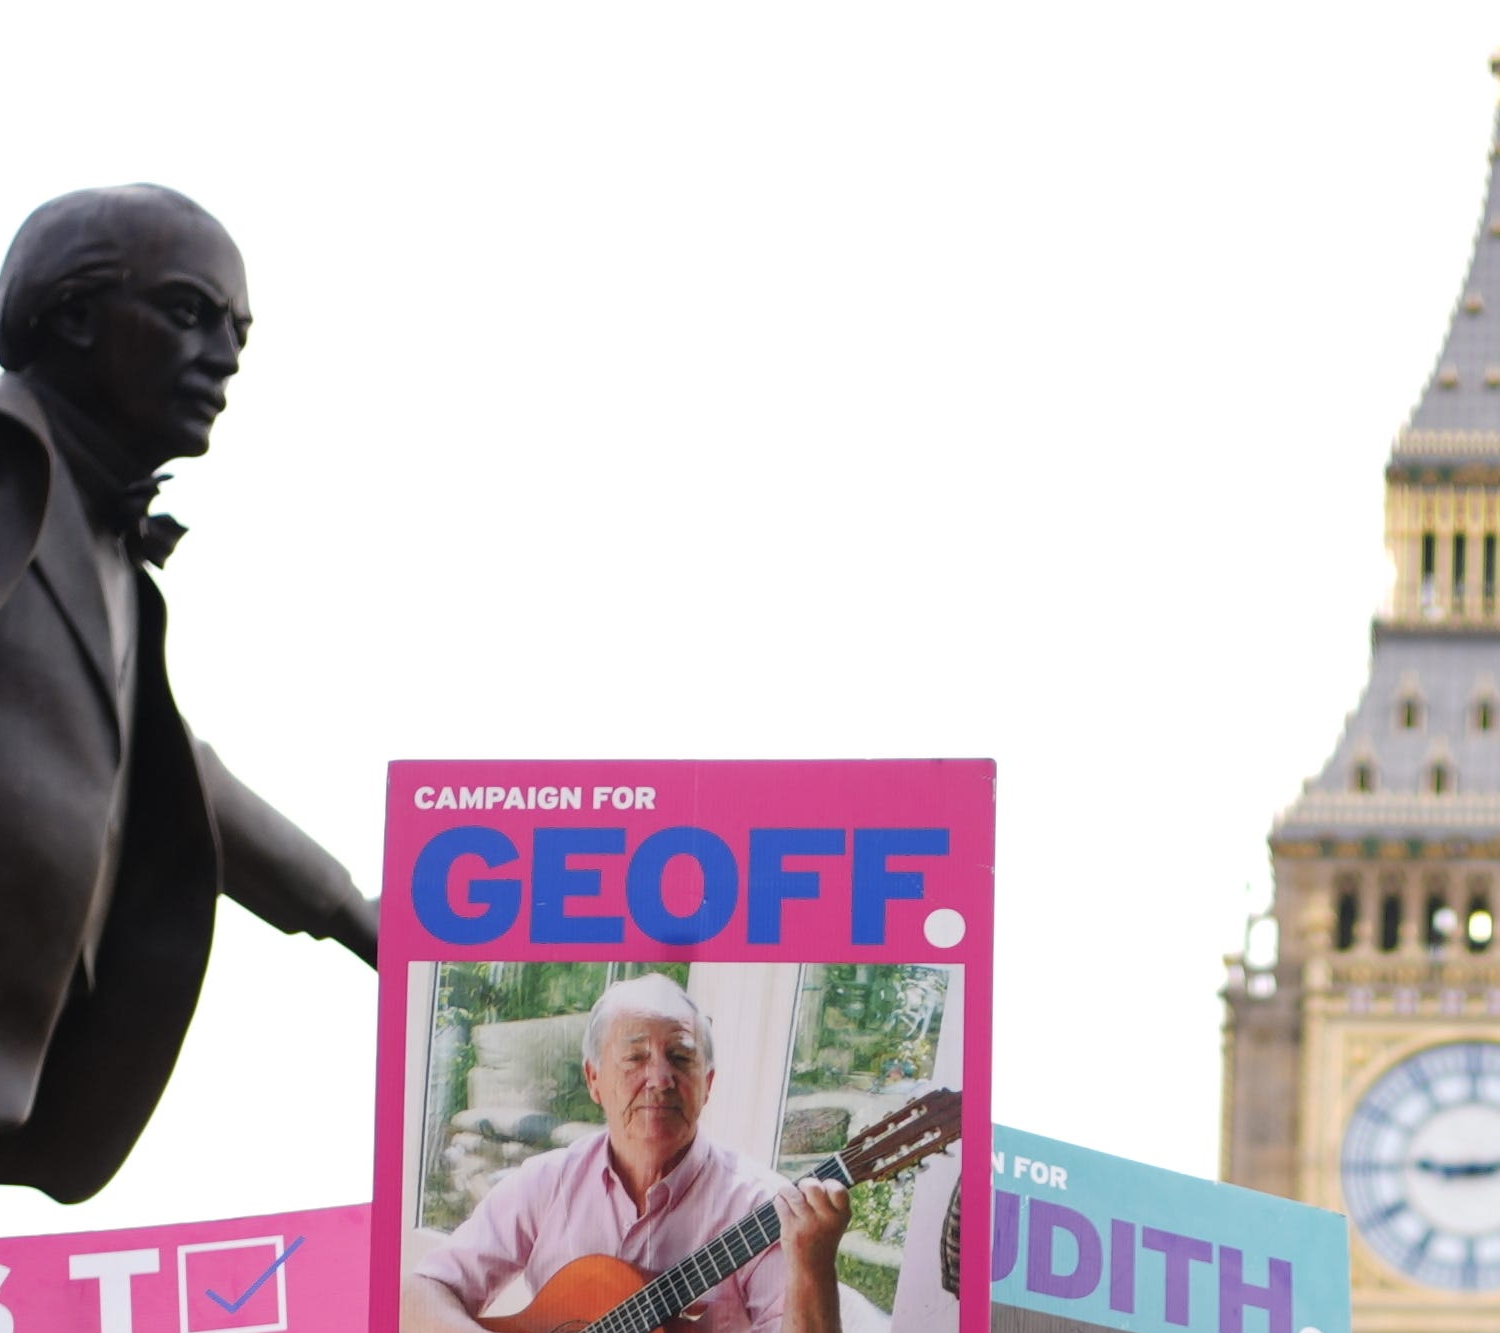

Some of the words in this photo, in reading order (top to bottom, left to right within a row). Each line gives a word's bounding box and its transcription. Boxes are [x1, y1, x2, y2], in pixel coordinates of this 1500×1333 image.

[415, 787, 581, 809] CAMPAIGN
[594, 787, 655, 809] FOR
[410, 825, 965, 948] GEOFF.
[1015, 1157, 1066, 1189] FOR
